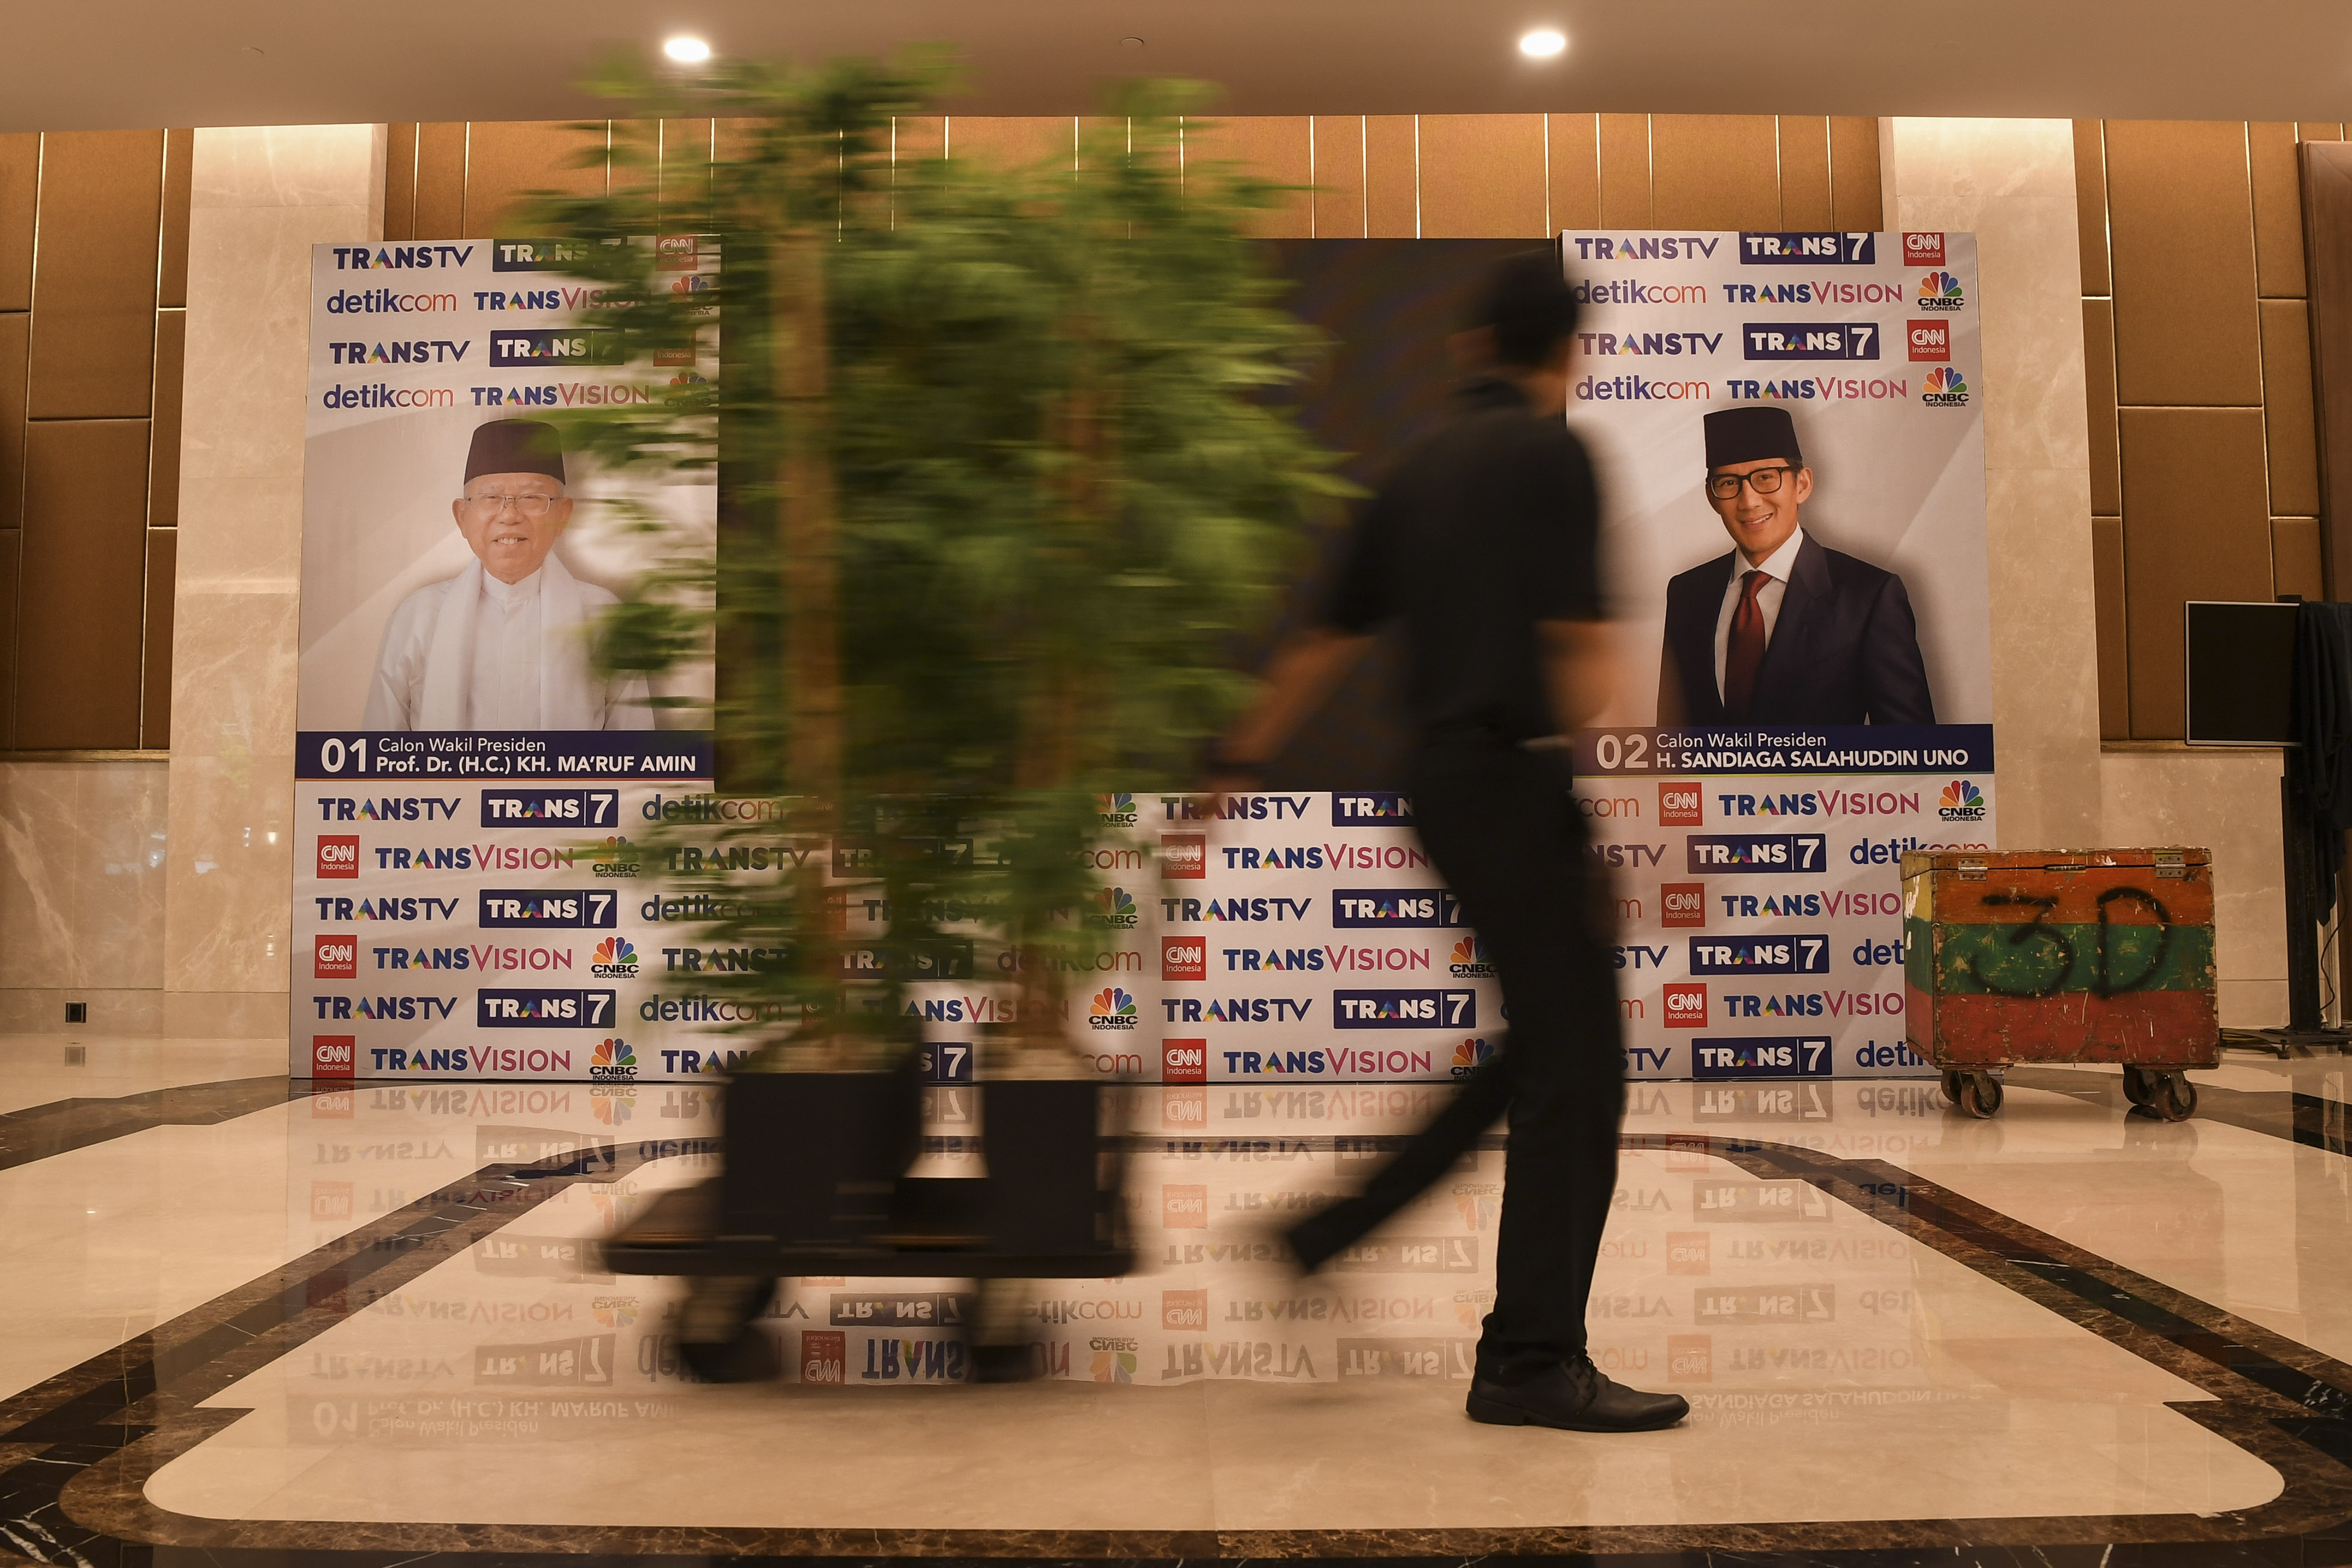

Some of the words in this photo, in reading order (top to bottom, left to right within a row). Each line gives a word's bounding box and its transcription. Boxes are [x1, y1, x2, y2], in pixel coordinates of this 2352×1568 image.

[660, 238, 693, 255] CNN
[1575, 238, 1719, 260] TRANSTV
[1747, 238, 1836, 256] TRANS
[1847, 233, 1869, 260] 7
[1906, 234, 1940, 250] CNN
[333, 246, 473, 270] TRANSTV
[1907, 250, 1940, 259] Indonesia
[327, 289, 456, 314] detikcom
[1573, 279, 1706, 304] detikcom
[1723, 281, 1903, 305] TRANSVISION
[1918, 297, 1965, 306] CNBC
[497, 339, 586, 357] TRANS
[1578, 333, 1723, 355] TRANSTV
[1750, 332, 1841, 351] TRANS
[1852, 328, 1873, 356] 7
[1910, 329, 1945, 346] CNN
[329, 340, 470, 364] TRANSTV
[323, 383, 453, 409] detikcom
[471, 383, 649, 406] TRANSVISION
[1575, 376, 1710, 400] detikcom
[1727, 377, 1907, 400] TRANSVISION
[1922, 393, 1969, 402] CNBC
[379, 738, 424, 753] Calon
[429, 738, 473, 753] Wakil
[477, 738, 546, 753] Presiden
[1596, 734, 1648, 768] 02
[1656, 734, 1703, 748] Calon
[1708, 734, 1752, 748] Wakil
[1758, 733, 1826, 748] Presiden
[321, 738, 368, 773] 01
[376, 757, 420, 773] Prof.
[427, 757, 453, 772] Dr.
[459, 756, 511, 774] (H.C.)
[517, 757, 550, 771] KH.
[640, 756, 696, 771] AMIN
[1656, 753, 1676, 768] H.
[1681, 751, 1786, 768] SANDIAGA
[1790, 750, 1917, 767] SALAHUDDIN
[1923, 750, 1969, 765] UNO
[318, 798, 461, 821] TRANSTV
[489, 799, 579, 818] TRANS
[590, 794, 613, 824] 7
[643, 794, 783, 820] detikcom
[1339, 798, 1412, 817] TRAN
[1663, 793, 1697, 810] CNN
[1718, 790, 1919, 817] TRANSVISION
[1939, 808, 1986, 817] CNBC
[320, 844, 355, 861] CNN
[375, 844, 573, 871] TRANSVISION
[663, 847, 812, 870] TRANSTV
[1166, 845, 1201, 862] CNN
[1695, 844, 1786, 864] TRANS
[1798, 840, 1819, 869] 7
[320, 862, 354, 871] Indonesia
[593, 863, 640, 872] CNBC
[315, 898, 459, 921] TRANSTV
[487, 900, 577, 918] TRANS
[589, 894, 612, 924] 7
[1161, 898, 1312, 922] TRANSTV
[1340, 899, 1434, 918] TRANS
[1446, 894, 1461, 924] 7
[1665, 893, 1700, 910] CNN
[1722, 891, 1900, 918] TRANSVISIO
[1665, 910, 1700, 918] Indonesia
[318, 944, 352, 962] CNN
[1697, 946, 1789, 965] TRANS
[1800, 940, 1822, 969] 7
[1970, 886, 2174, 1000] 3D
[318, 962, 352, 971] Indonesia
[373, 944, 572, 971] TRANSVISION
[1166, 947, 1201, 963] CNN
[1223, 945, 1430, 972] TRANSVISION
[591, 964, 639, 974] CNBC
[313, 997, 457, 1019] TRANSTV
[485, 999, 576, 1018] TRANS
[587, 994, 610, 1024] 7
[1162, 999, 1312, 1022] TRANSTV
[1341, 999, 1435, 1018] TRANS
[1447, 995, 1469, 1024] 7
[1668, 994, 1702, 1011] CNN
[1723, 990, 1904, 1018] TRANSVISIO
[1089, 1016, 1138, 1024] CNBC
[1668, 1011, 1703, 1019] Indonesia
[316, 1045, 350, 1062] CNN
[371, 1045, 570, 1072] TRANSVISION
[944, 1047, 966, 1077] 7
[1167, 1049, 1201, 1066] CNN
[1224, 1047, 1431, 1075] TRANSVISION
[1700, 1047, 1792, 1066] TRANS
[1804, 1041, 1825, 1071] 7
[316, 1063, 350, 1071] Indonesia
[589, 1065, 637, 1075] CNBC
